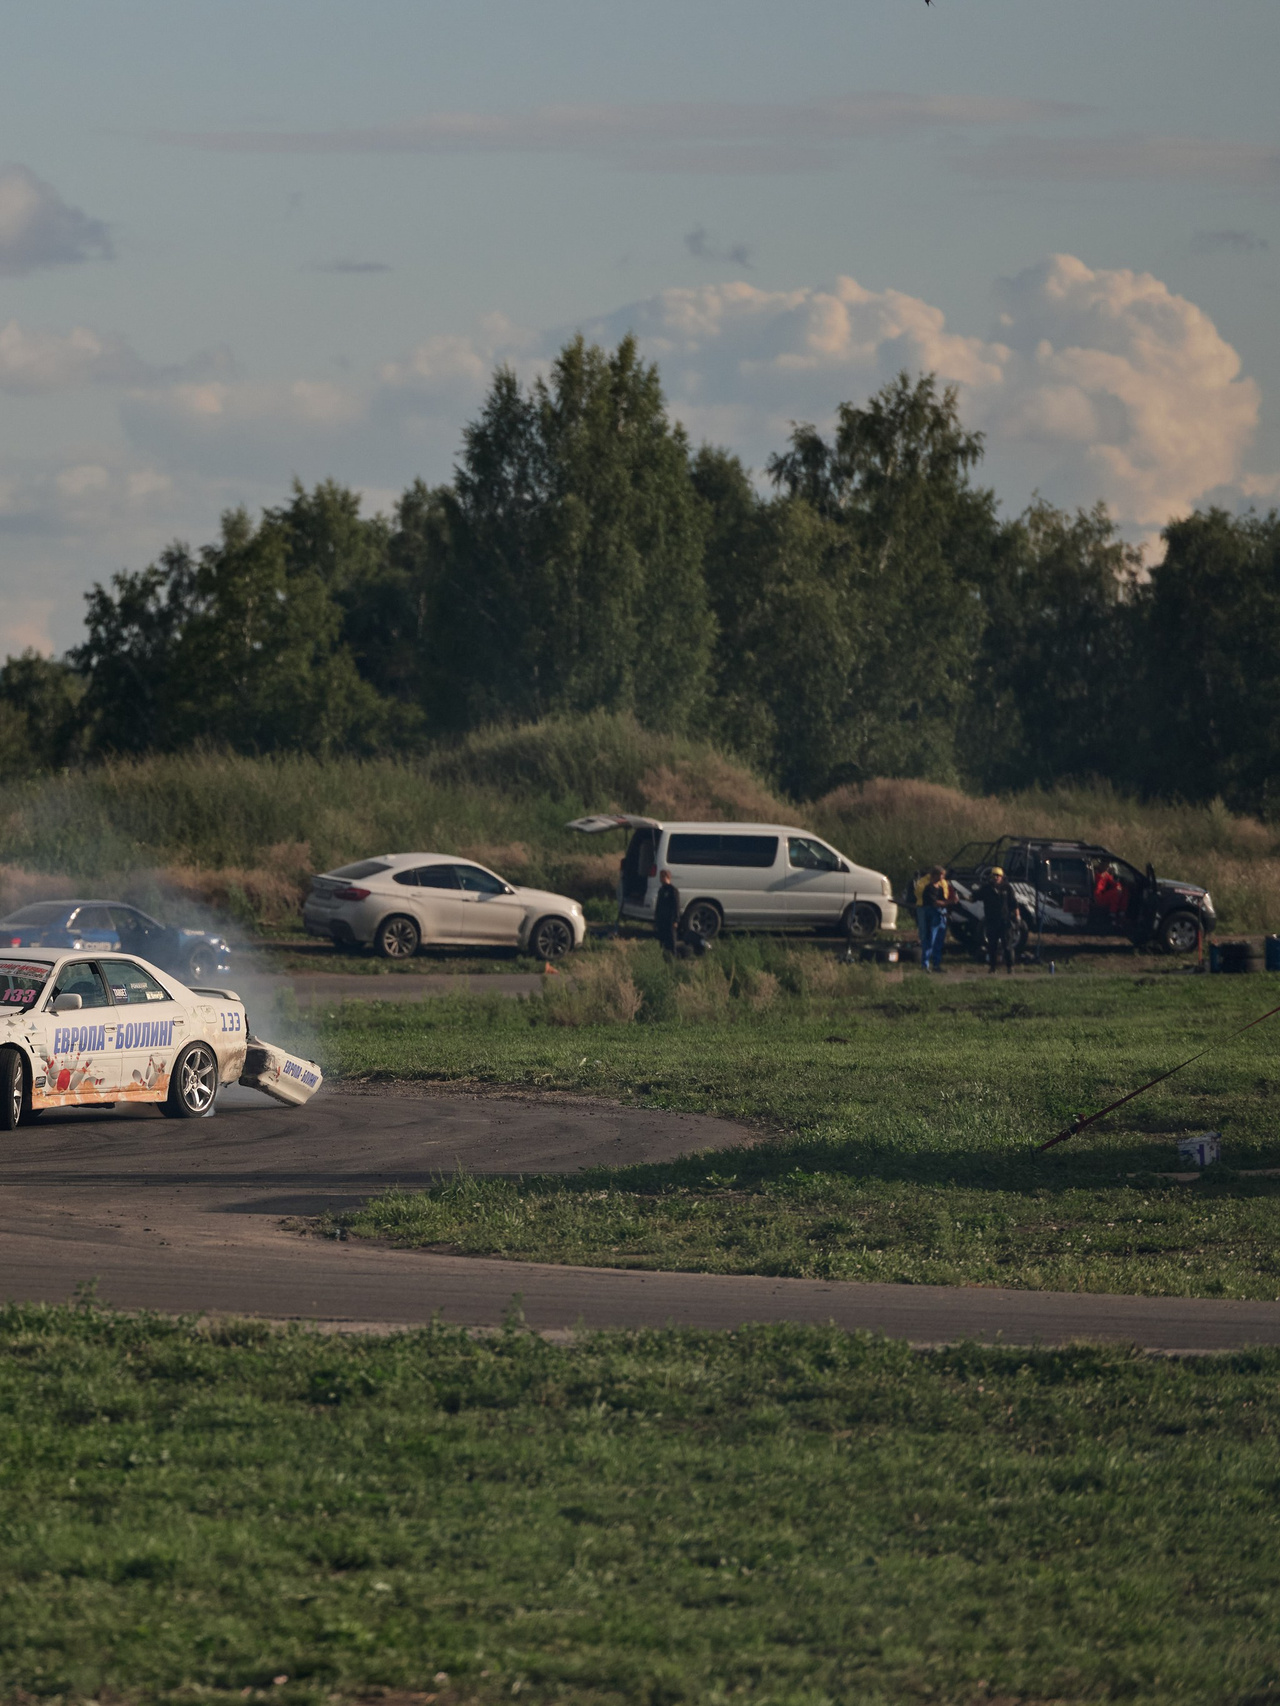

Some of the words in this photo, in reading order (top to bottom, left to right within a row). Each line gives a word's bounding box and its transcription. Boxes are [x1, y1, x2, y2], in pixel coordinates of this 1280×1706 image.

[2, 988, 37, 1004] 133
[221, 1012, 241, 1032] 133
[54, 1024, 106, 1054] ЕВРОПА
[115, 1020, 174, 1050] БОУЛИНГ
[283, 1060, 302, 1080] ЕВРОПА
